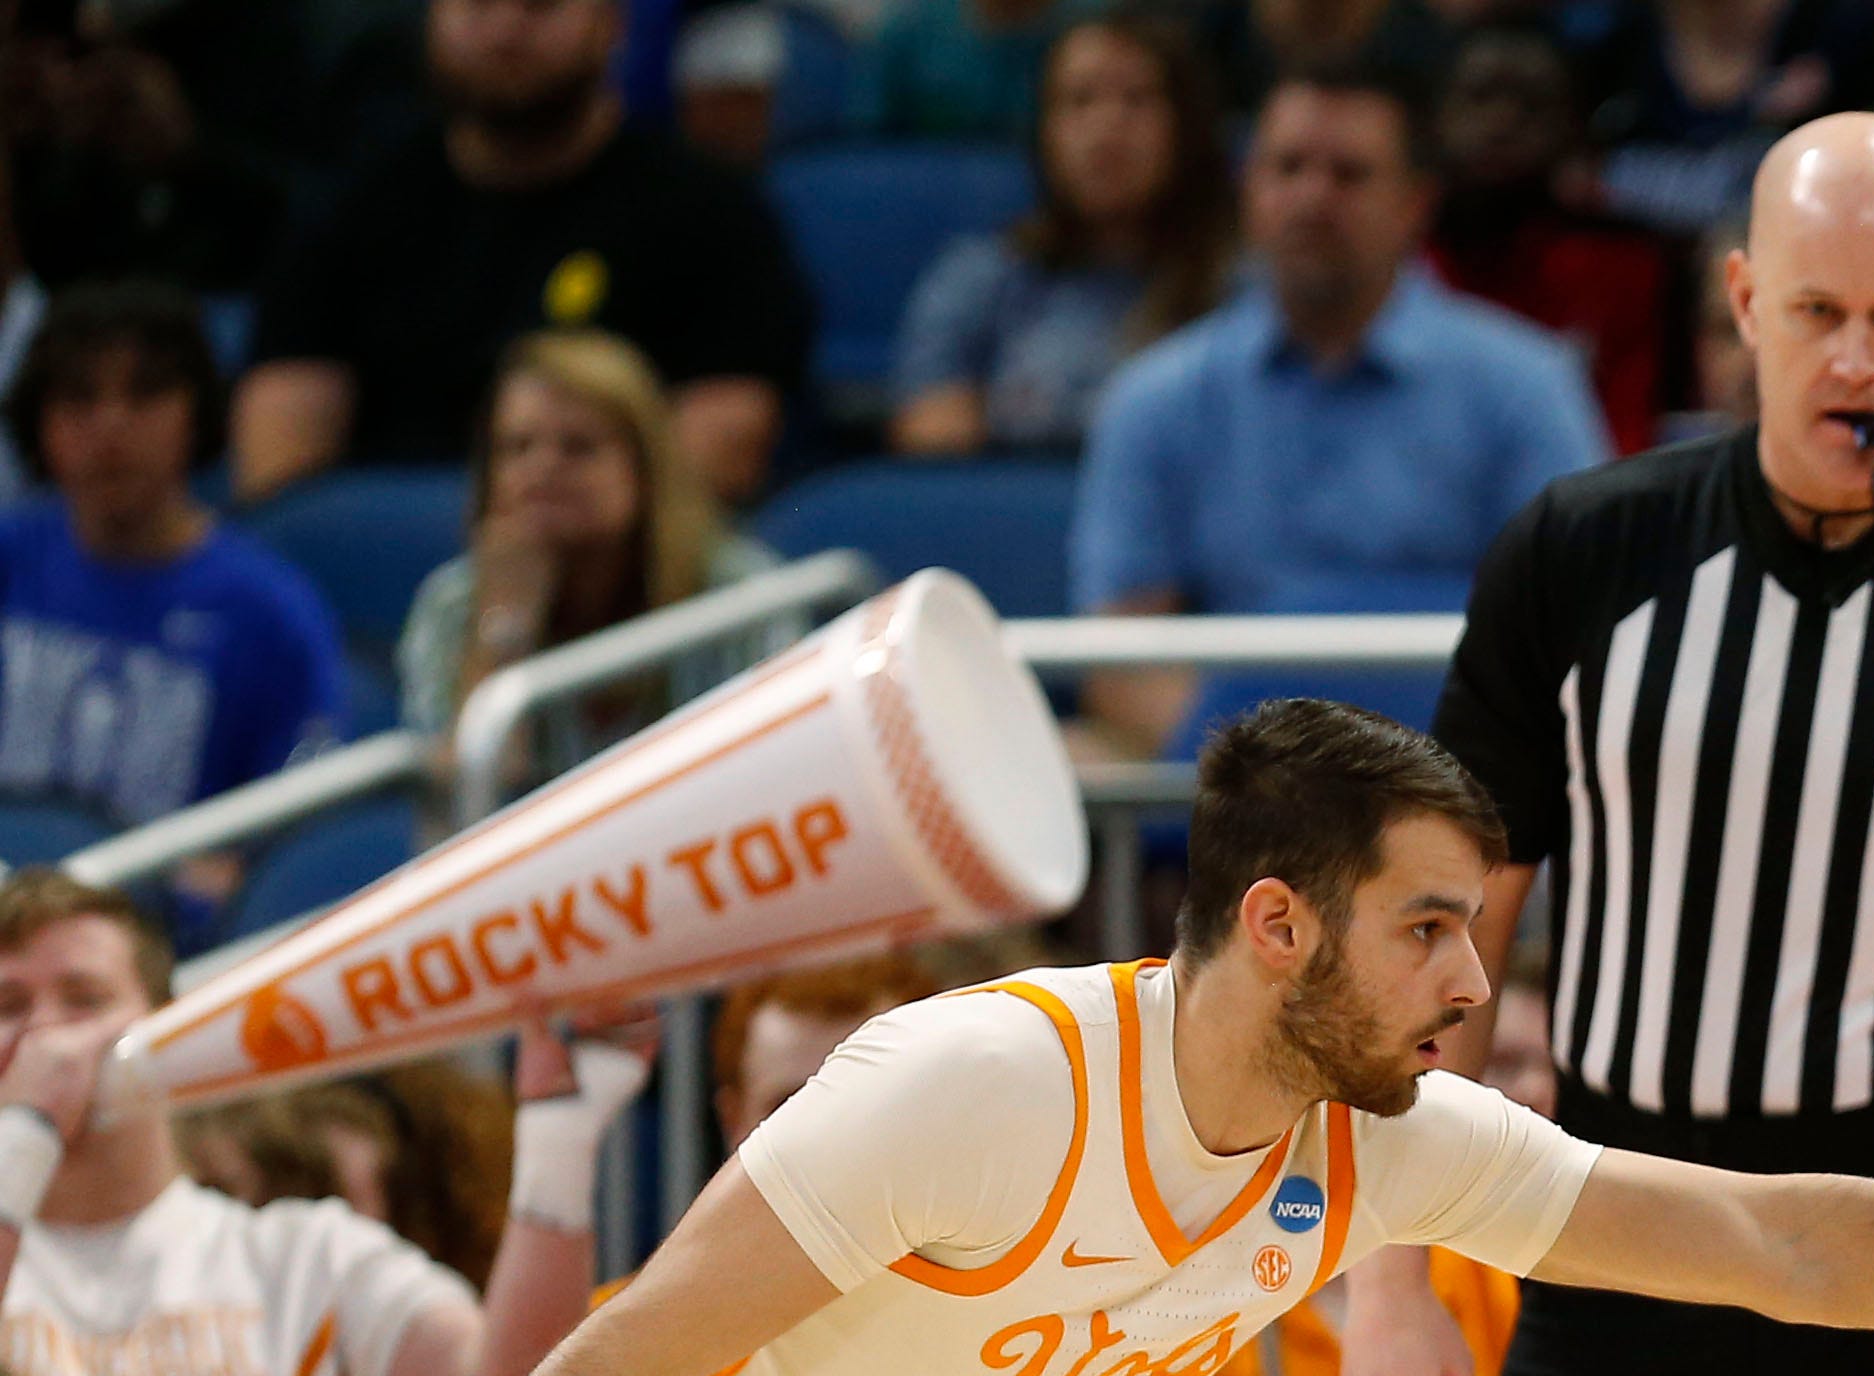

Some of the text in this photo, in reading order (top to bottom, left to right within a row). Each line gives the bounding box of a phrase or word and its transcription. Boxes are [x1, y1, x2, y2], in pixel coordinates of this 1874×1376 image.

[342, 793, 850, 1030] ROCKY TOP
[1276, 1201, 1321, 1220] NCAA
[1257, 1249, 1288, 1287] SEC
